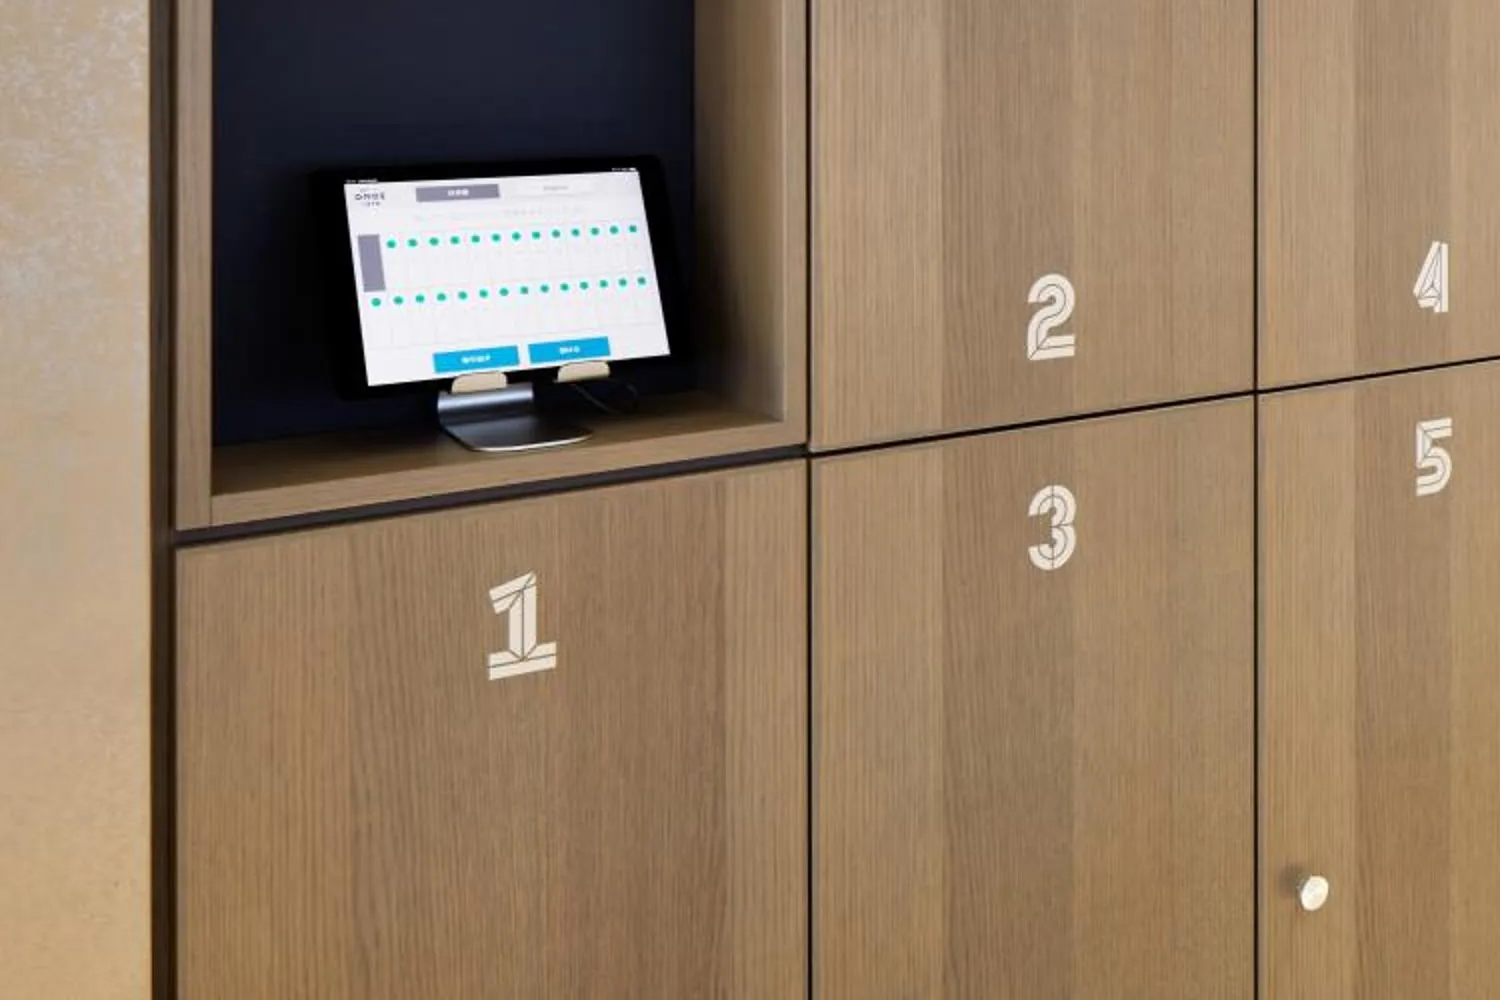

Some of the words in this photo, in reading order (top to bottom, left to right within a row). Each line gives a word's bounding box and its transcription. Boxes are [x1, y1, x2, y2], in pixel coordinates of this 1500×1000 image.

[1027, 273, 1075, 361] 2
[1413, 241, 1449, 313] 4
[1415, 417, 1453, 496] 5
[1028, 485, 1077, 571] 3
[488, 572, 557, 681] 1
